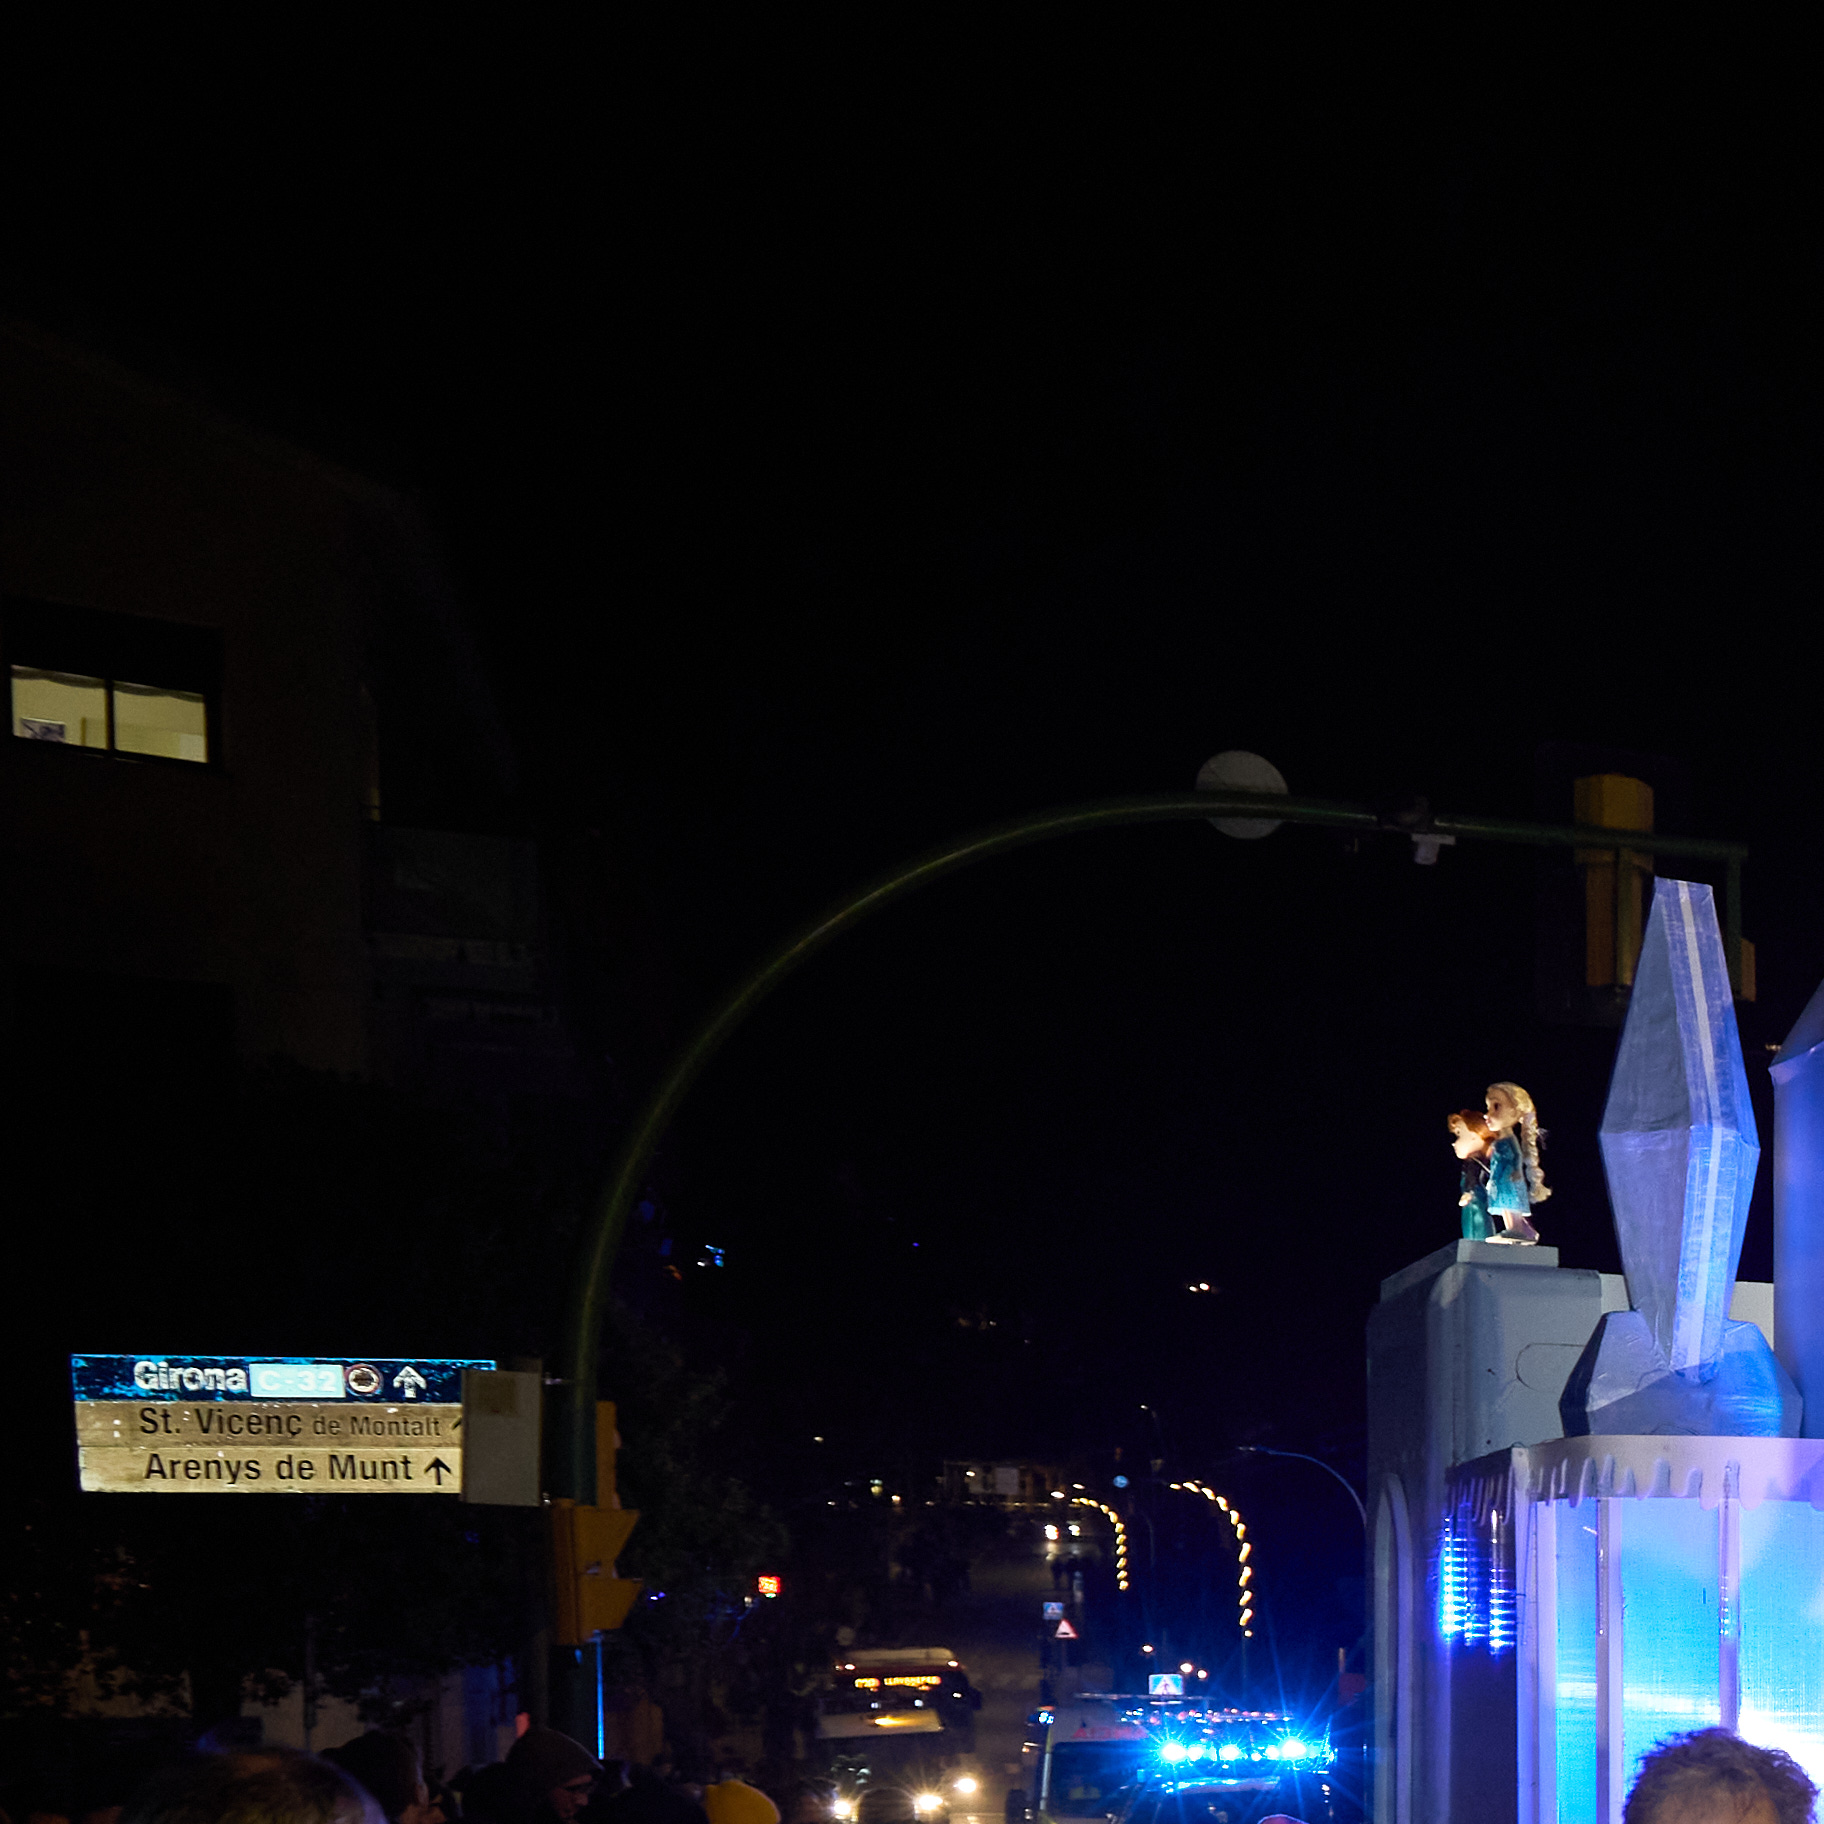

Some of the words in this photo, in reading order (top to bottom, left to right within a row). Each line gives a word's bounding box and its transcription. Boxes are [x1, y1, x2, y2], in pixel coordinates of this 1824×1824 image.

[134, 1361, 248, 1391] Girona
[258, 1370, 337, 1392] C-32
[140, 1408, 180, 1434] St.
[195, 1408, 302, 1438] Vicenç
[313, 1416, 340, 1435] de
[351, 1416, 440, 1436] Montalt
[145, 1453, 261, 1484] Arenys
[277, 1454, 314, 1479] de
[329, 1455, 413, 1480] Munt
